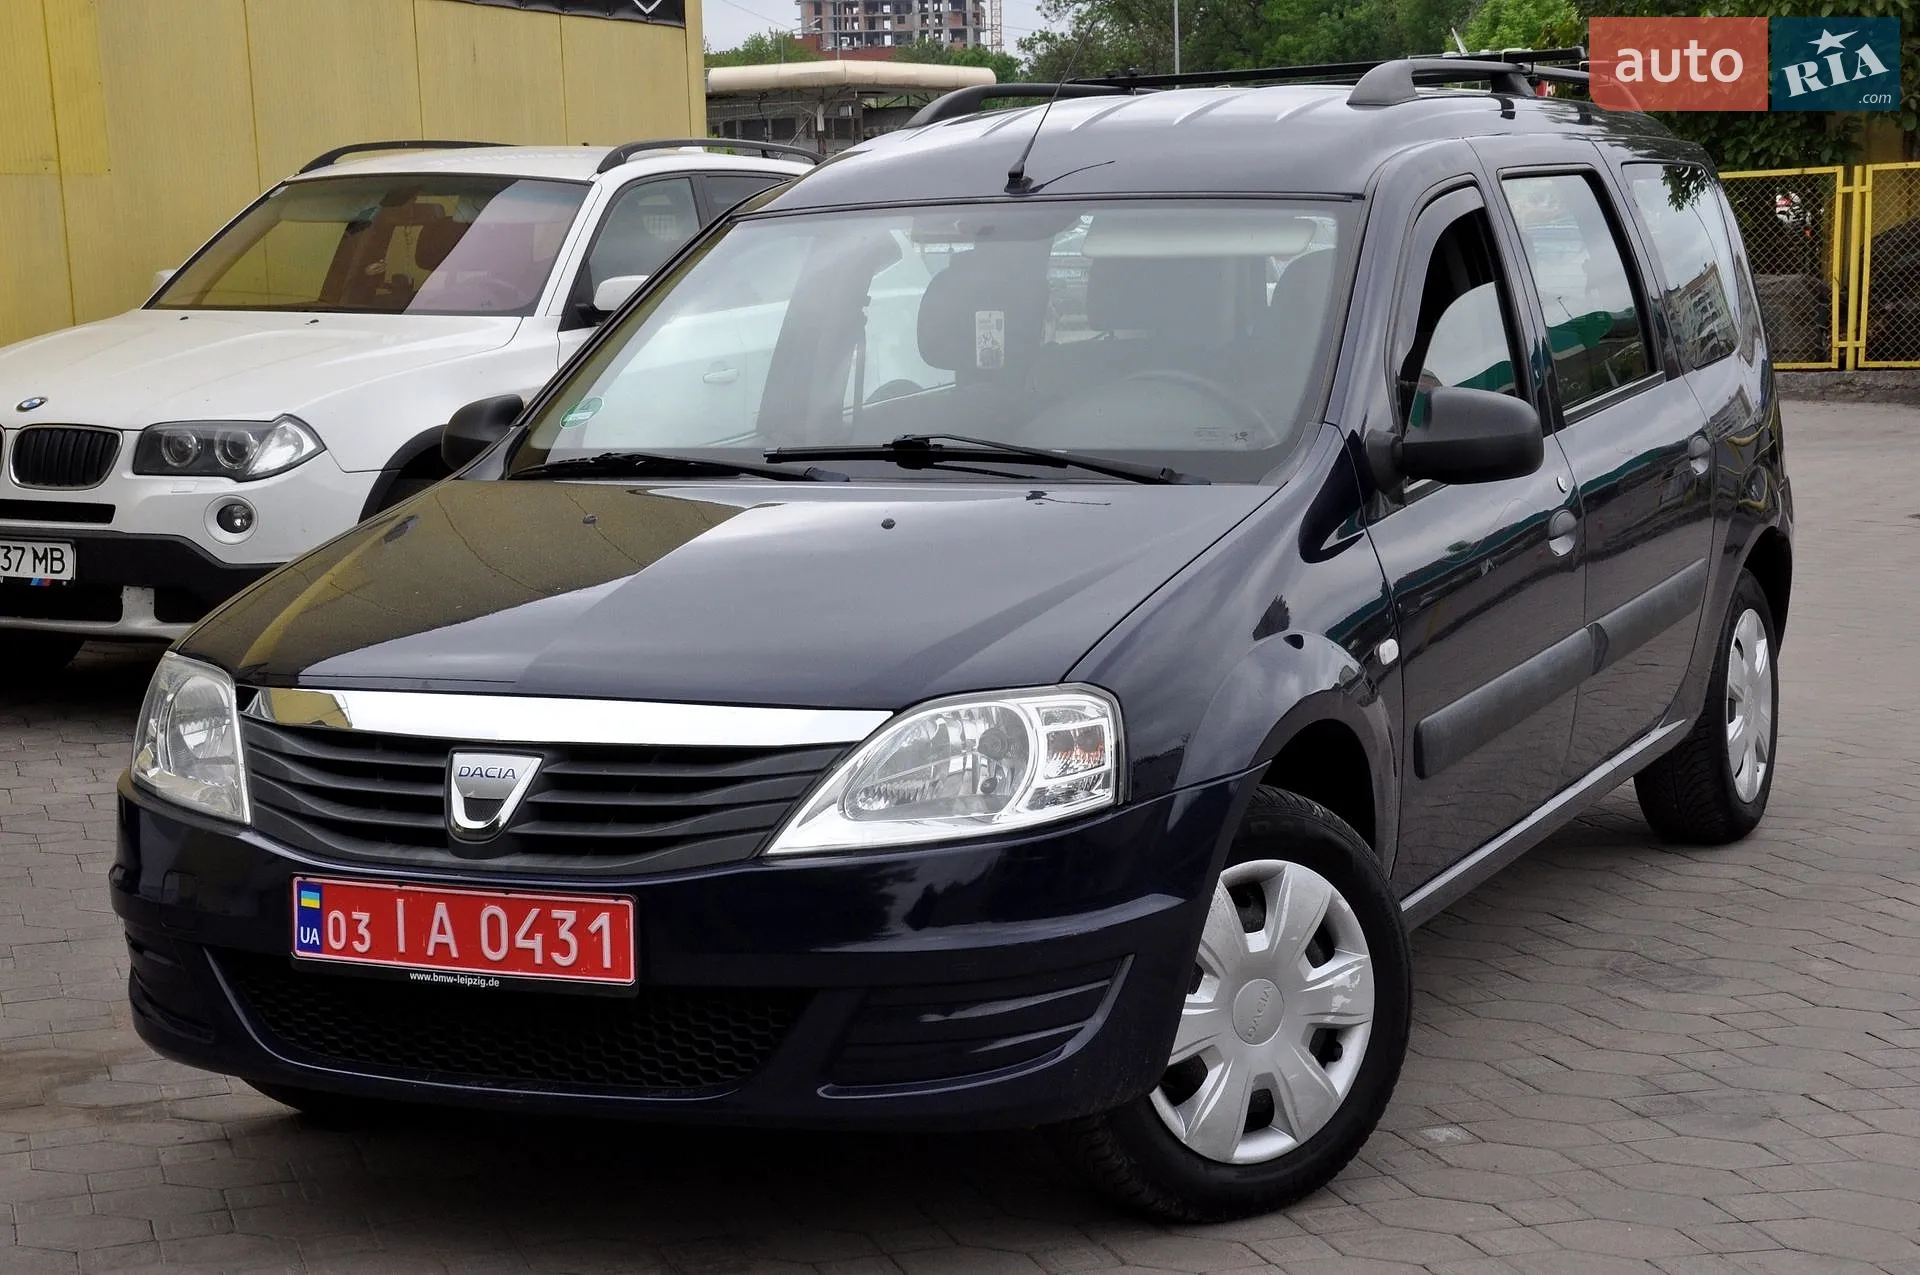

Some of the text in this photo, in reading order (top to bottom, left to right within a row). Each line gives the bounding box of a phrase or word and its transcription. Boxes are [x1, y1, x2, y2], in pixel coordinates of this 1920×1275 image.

[0, 545, 66, 574] 37 MB
[458, 766, 517, 780] DACIA
[300, 926, 320, 946] UA
[327, 909, 372, 953] 03
[479, 904, 612, 970] 0431
[409, 972, 501, 988] www.bmw-leipzig.de
